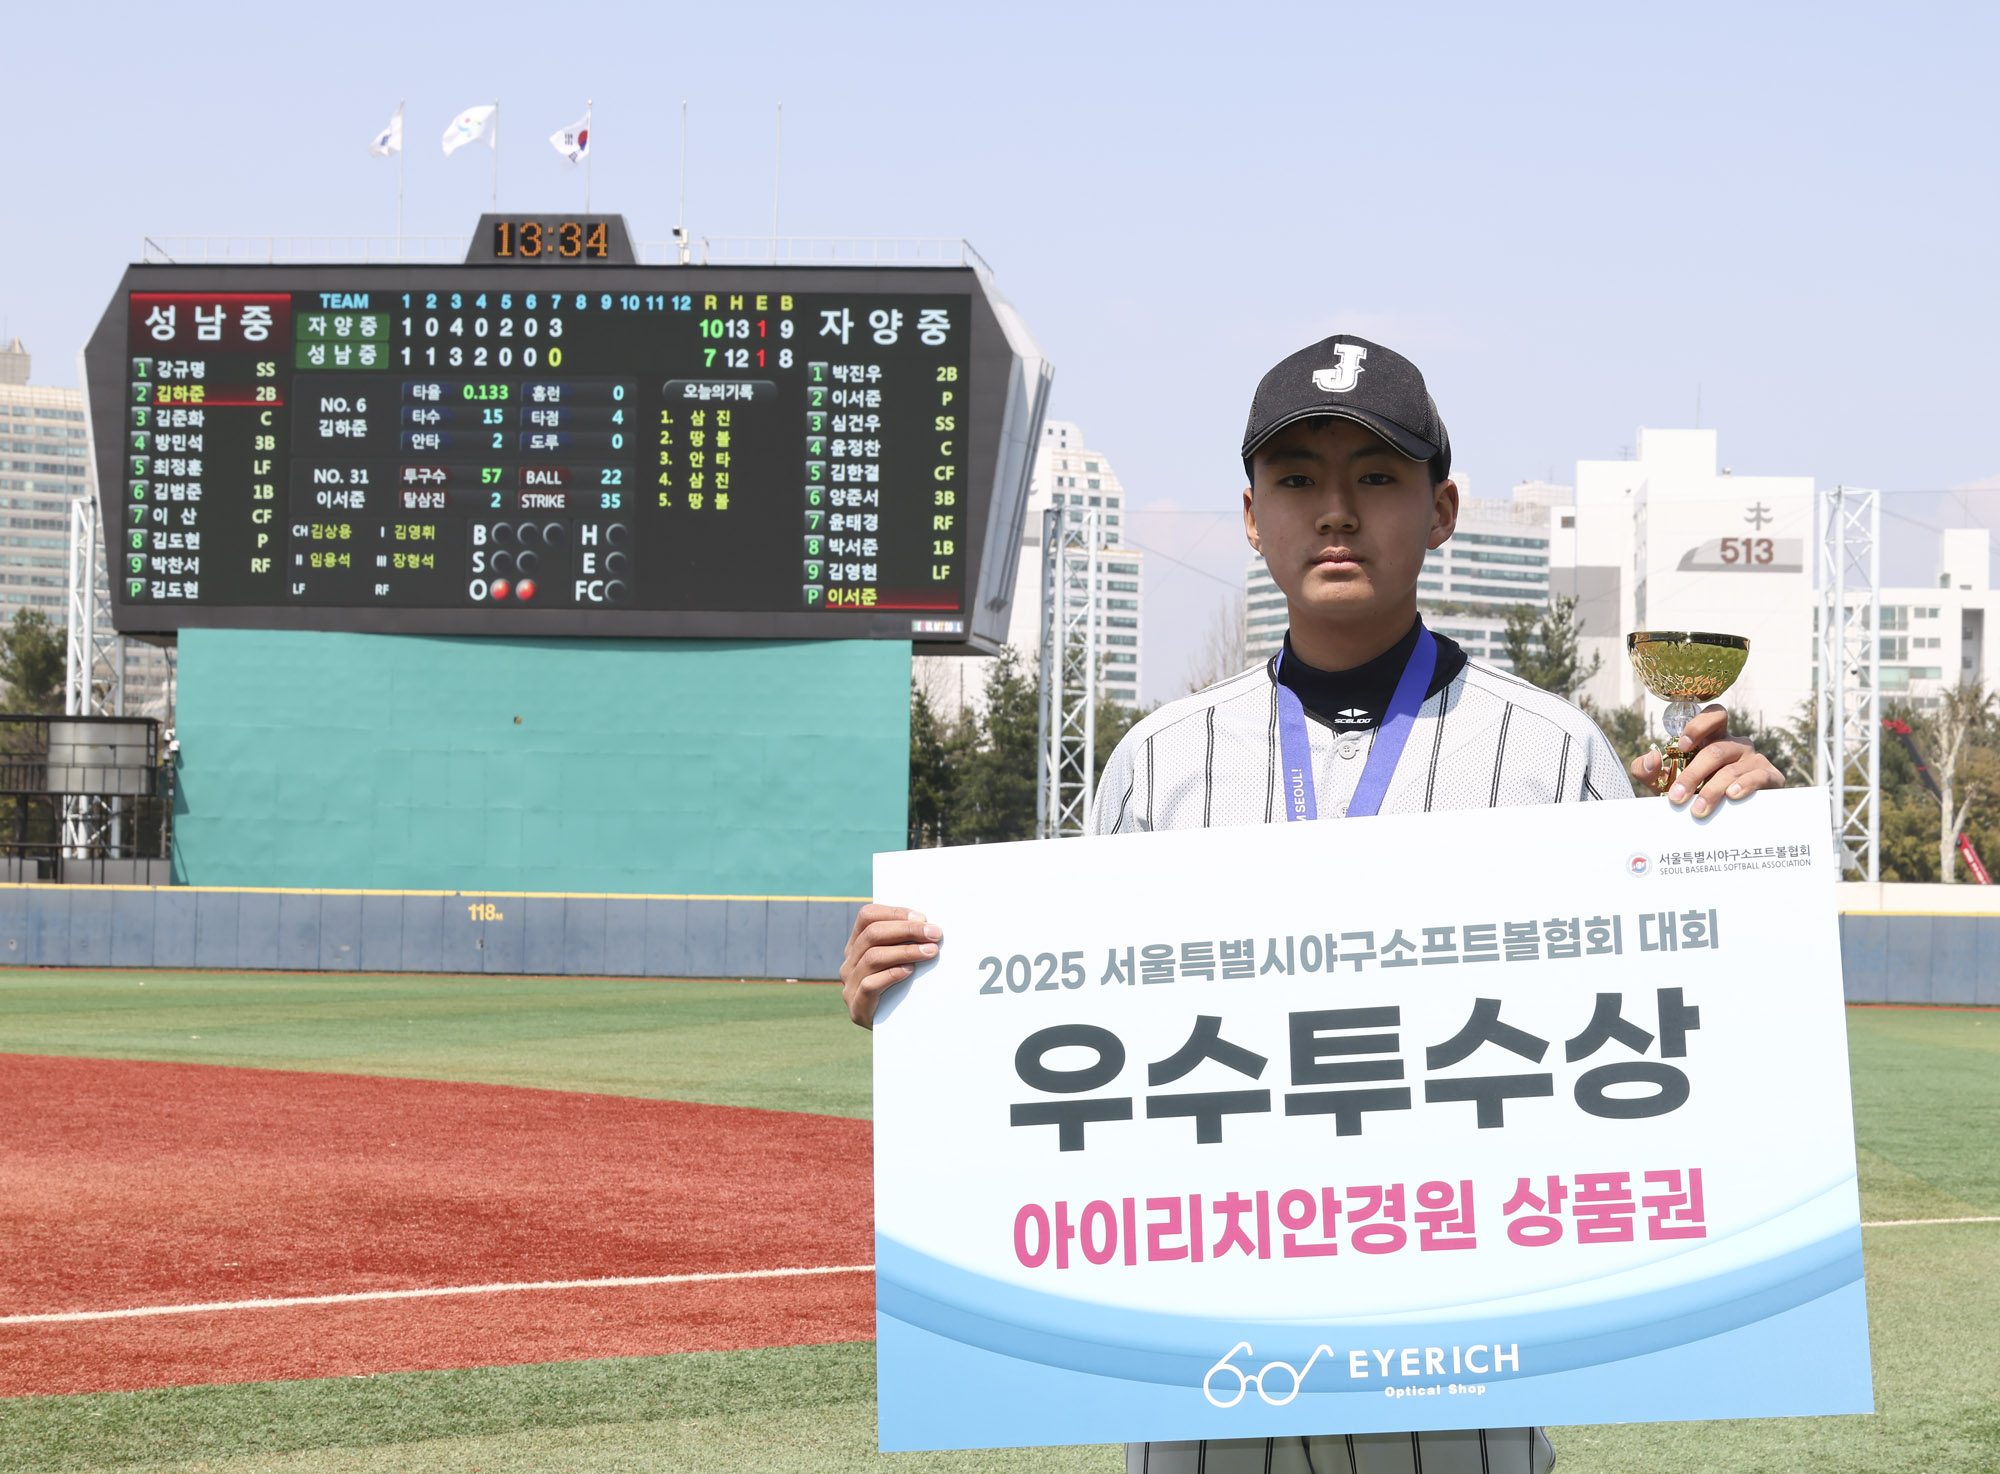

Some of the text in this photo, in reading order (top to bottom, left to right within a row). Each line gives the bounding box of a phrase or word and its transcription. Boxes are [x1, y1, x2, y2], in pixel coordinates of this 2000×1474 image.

[497, 222, 608, 257] 13:34
[320, 294, 793, 311] TEAM 1 2 3 4 5 6 7 8 9 10 11 12 R H E B
[402, 318, 411, 336] 1
[426, 318, 438, 336] 0
[450, 318, 463, 336] 4
[475, 318, 488, 337] 0
[500, 318, 513, 336] 2
[525, 318, 537, 337] 0
[549, 318, 562, 337] 3
[700, 319, 724, 338] 10
[725, 319, 749, 338] 13
[757, 320, 766, 337] 1
[781, 320, 794, 339] 9
[402, 347, 410, 365] 1
[426, 347, 435, 365] 1
[450, 347, 462, 366] 3
[474, 347, 487, 366] 2
[499, 347, 512, 366] 0
[524, 348, 537, 366] 0
[549, 348, 561, 367] 0
[704, 349, 716, 367] 7
[725, 349, 749, 367] 12
[757, 349, 765, 367] 1
[779, 349, 793, 368] 8
[137, 362, 275, 377] 1 SS
[813, 365, 957, 383] 1 박진우 2B
[1312, 343, 1368, 393] J
[136, 385, 276, 402] 2 김하준 2B
[463, 384, 508, 400] 0.133
[613, 385, 624, 400] 0
[684, 384, 753, 400] 오늘의기록
[812, 390, 953, 408] 2 이서준 P
[321, 398, 366, 412] NO. 6
[135, 411, 146, 426] 3
[261, 411, 272, 425] C
[413, 409, 623, 426] 타수 15 타점 4
[811, 414, 954, 432] 3 심건우 SS
[319, 419, 367, 437] 김하준
[134, 434, 275, 452] 4 방민석 3B
[412, 433, 623, 450] 안타 2 도루 0
[810, 441, 821, 455] 4
[941, 441, 952, 456] C
[134, 460, 271, 475] 5 LF
[314, 469, 369, 484] NO. 31
[404, 468, 622, 484] 투구수 57 BALL 22
[810, 465, 954, 481] 5 CF
[133, 483, 273, 500] 6 김범준 1B
[317, 491, 365, 508] 이서준
[404, 492, 620, 508] 탈삼진 2 STRIKE 35
[809, 489, 955, 507] 6 양준서 3B
[133, 509, 272, 523] 7 CF
[809, 513, 953, 531] 7 윤태경 RF
[132, 532, 268, 550] 8 김도현 P
[474, 525, 486, 545] B
[582, 525, 597, 545] H
[809, 538, 954, 556] 8 박서준 1B
[1721, 538, 1773, 564] 513
[131, 558, 142, 573] 9
[251, 558, 271, 572] RF
[473, 551, 485, 573] S
[583, 553, 595, 574] E
[808, 563, 950, 581] 9 김영현 LF
[131, 581, 198, 599] P 김도현
[469, 579, 487, 600] O
[576, 580, 603, 601] FC
[808, 588, 877, 606] P 이서준
[1291, 768, 1306, 813] SEOUL!
[1660, 845, 1810, 866] 서울특별시야구소프트볼협회
[1660, 859, 1811, 875] SEOUL BASEBALL SOFTBALL ASSOCIATION
[979, 909, 1718, 994] 2025 서울특별시야구소프트볼협회 대회
[1009, 986, 1701, 1152] 우수투수상
[1014, 1168, 1706, 1269] 아이리치안경원 상품권
[1349, 1343, 1520, 1379] EYERICH
[1385, 1383, 1486, 1399] Optical Shop
